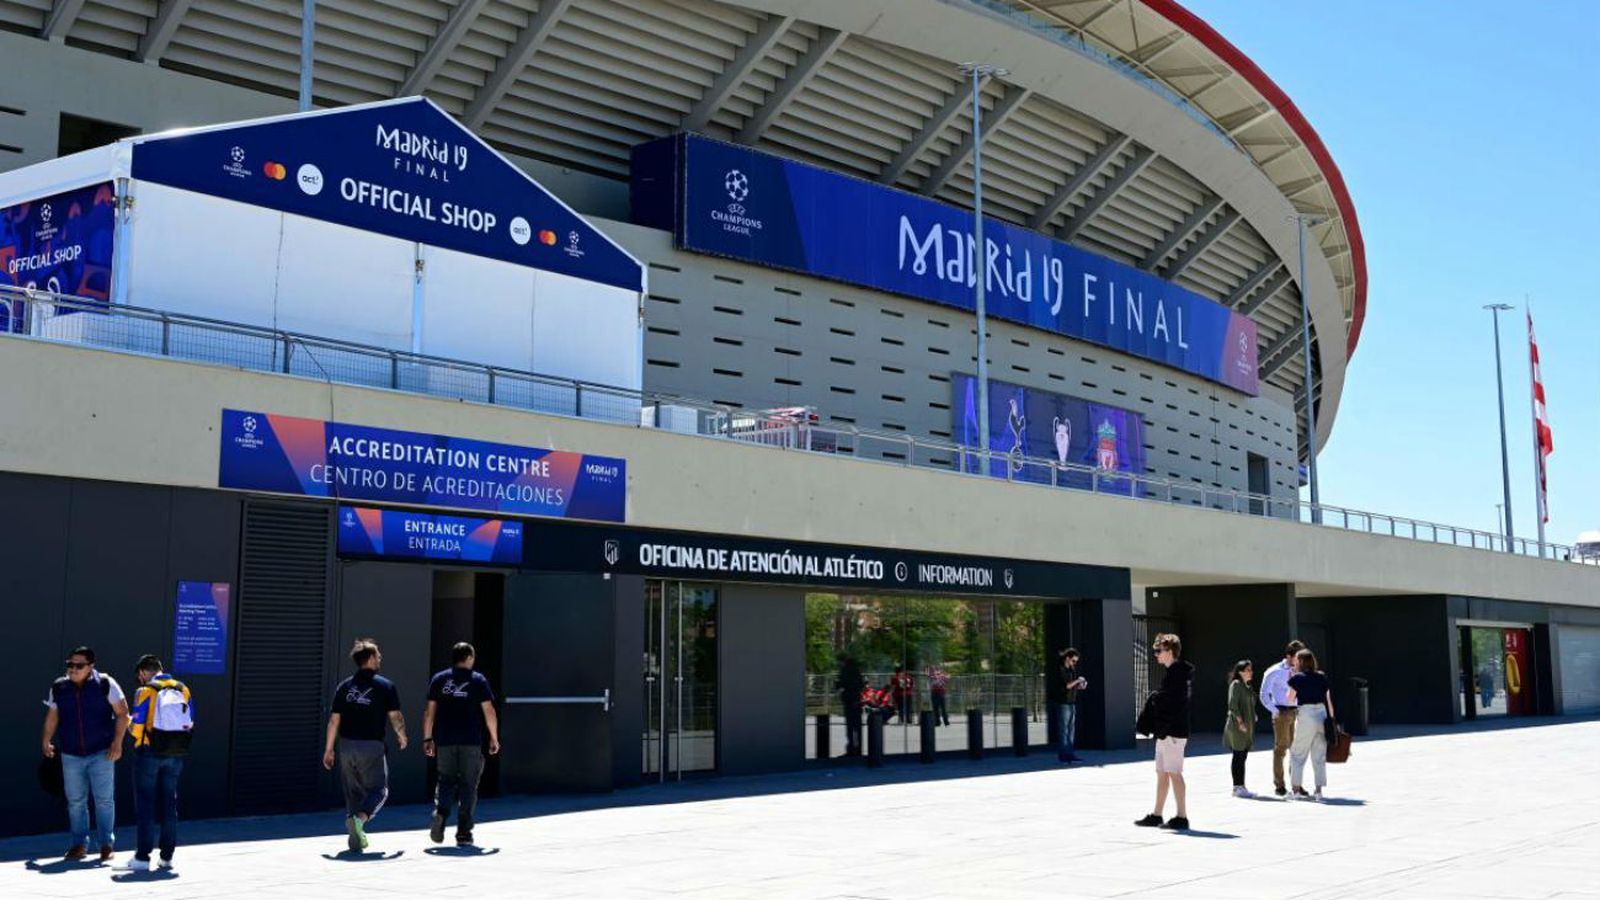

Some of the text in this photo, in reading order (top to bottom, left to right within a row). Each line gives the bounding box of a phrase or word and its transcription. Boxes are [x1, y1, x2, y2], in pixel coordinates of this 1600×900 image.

[393, 158, 449, 182] FINAL
[454, 145, 467, 171] 19
[340, 177, 497, 233] OFFICIAL SHOP
[711, 210, 762, 230] CHAMPIONS
[8, 244, 82, 274] OFFICIAL SHOP
[1043, 254, 1064, 316] 19
[1084, 273, 1188, 349] FINAL
[329, 436, 550, 478] ACCREDITATION CENTRE
[310, 464, 564, 506] CENTRO DE ACREDITACIONES
[404, 519, 465, 537] ENTRANCE
[409, 536, 461, 552] ENTRADA
[639, 543, 994, 587] OFICINA DE ATENCIÓN AL ATLÉTICO INFORMATION
